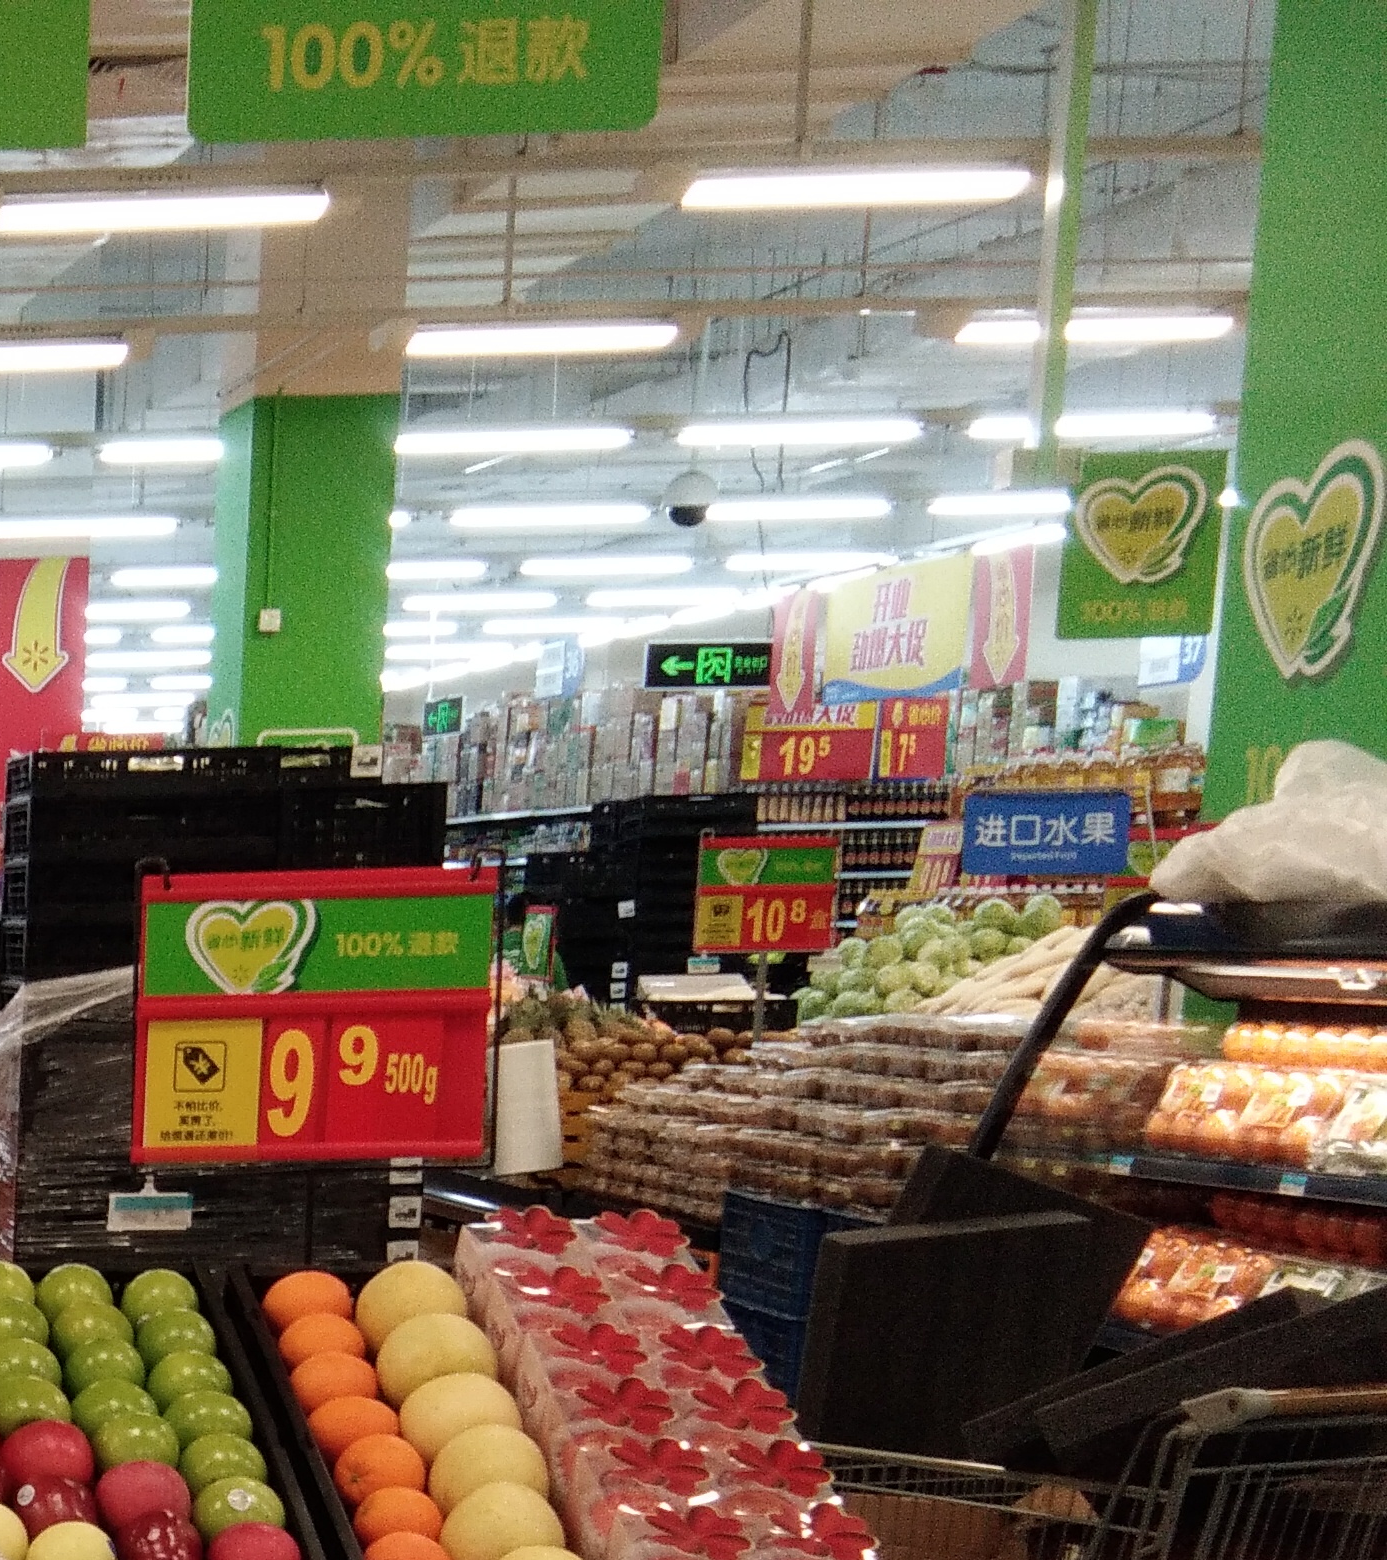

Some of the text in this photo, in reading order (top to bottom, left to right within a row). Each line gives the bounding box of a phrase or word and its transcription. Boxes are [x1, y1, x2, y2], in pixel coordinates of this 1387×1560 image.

[260, 16, 591, 90] 100% 退款
[975, 811, 1116, 848] 进口水果
[746, 897, 807, 943] 108
[336, 932, 403, 958] 100%
[384, 1053, 439, 1106] 500g
